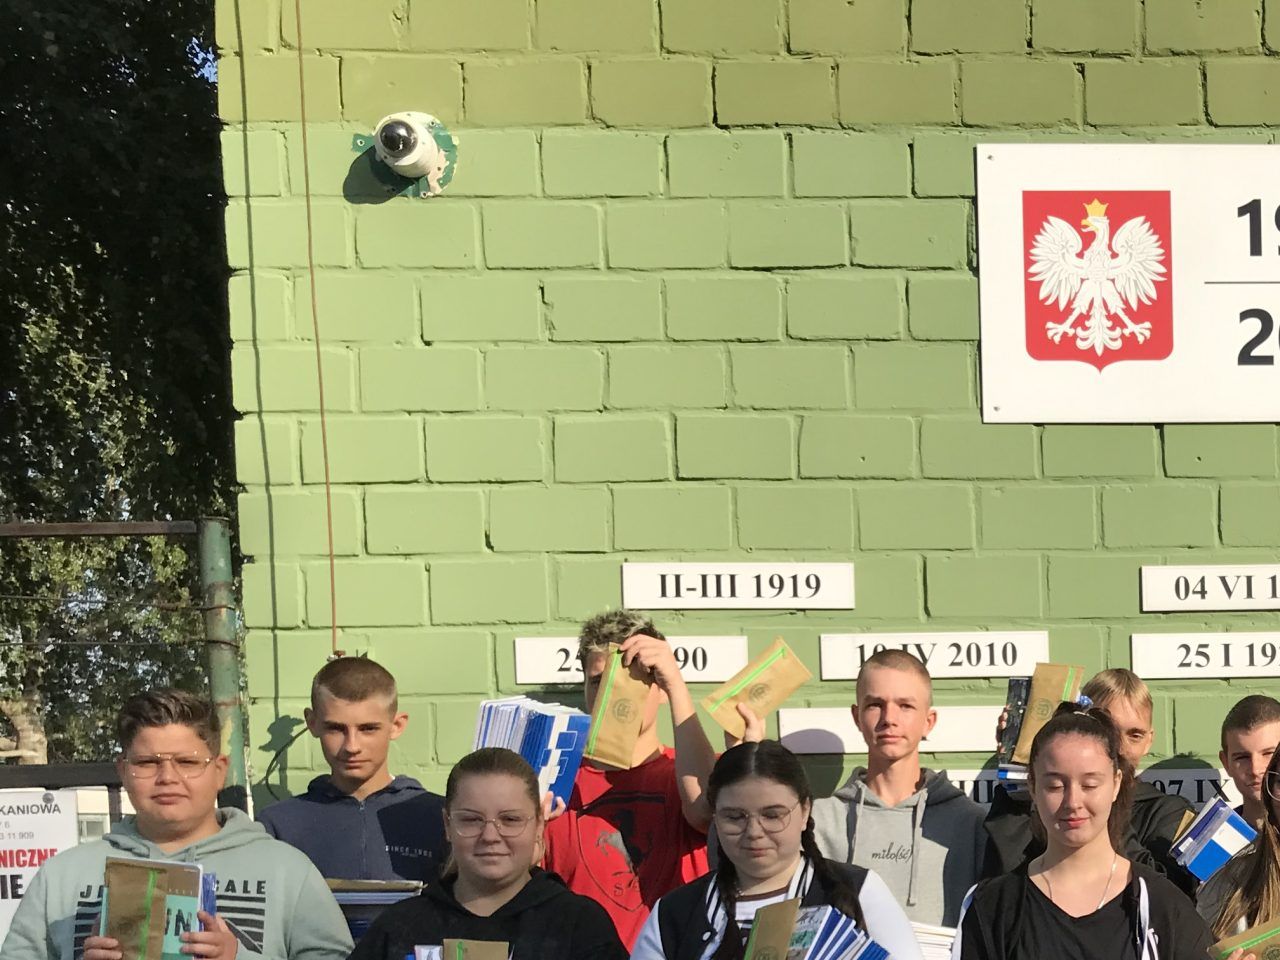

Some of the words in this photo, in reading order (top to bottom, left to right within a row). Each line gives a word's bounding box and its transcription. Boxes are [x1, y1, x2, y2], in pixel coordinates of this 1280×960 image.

[658, 573, 738, 599] II-III
[753, 573, 821, 598] 1919
[1174, 575, 1208, 600] 04
[1218, 575, 1255, 600] VI
[948, 641, 1018, 667] 2010
[1177, 643, 1211, 668] 25
[1221, 643, 1232, 668] I
[1194, 779, 1231, 803] IX
